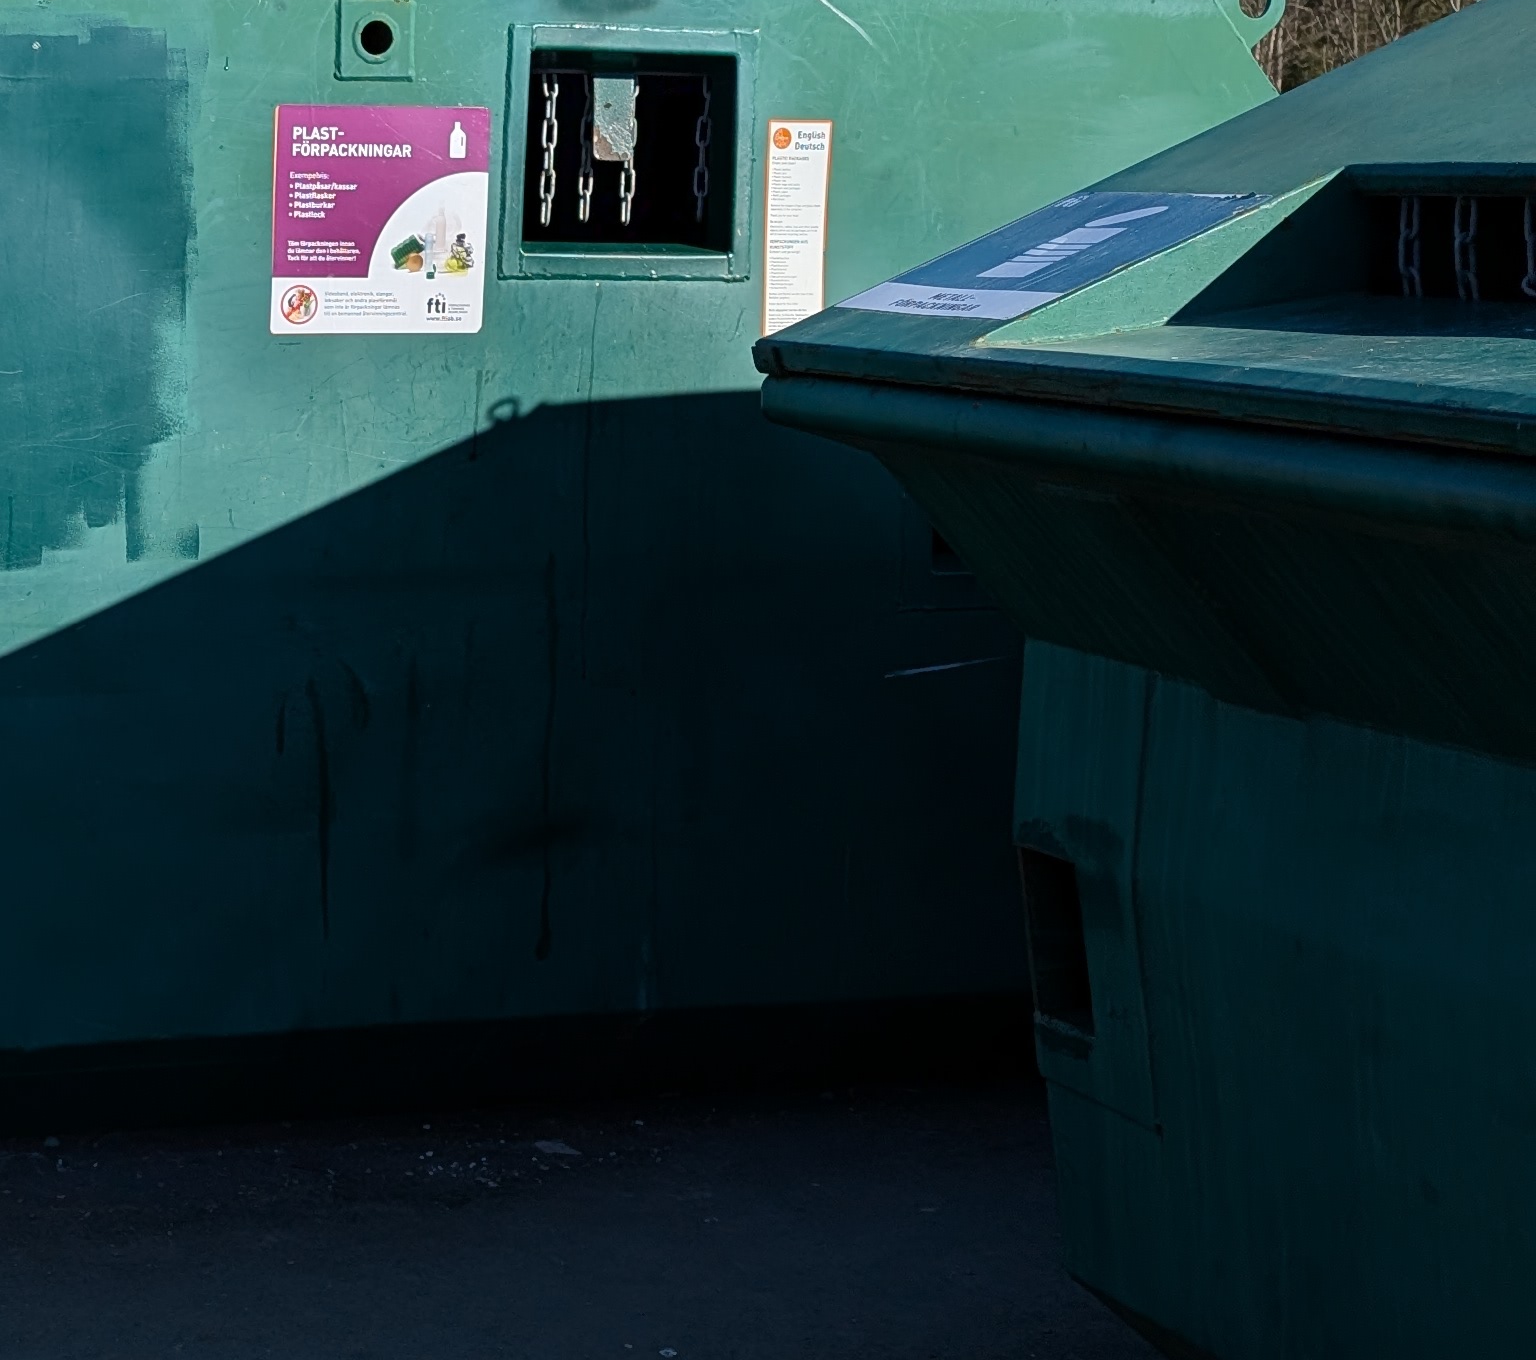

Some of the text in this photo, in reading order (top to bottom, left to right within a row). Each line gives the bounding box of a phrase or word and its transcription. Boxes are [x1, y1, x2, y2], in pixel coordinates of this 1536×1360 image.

[292, 126, 344, 140] PLAST-
[797, 130, 825, 141] English
[292, 141, 412, 157] FÖRPACKNINGAR
[795, 141, 825, 150] Deutsch
[294, 182, 358, 191] Plastpåsar/kassar
[294, 192, 337, 200] Plastflaskor
[293, 201, 336, 209] Plastburkar
[427, 297, 446, 314] fti
